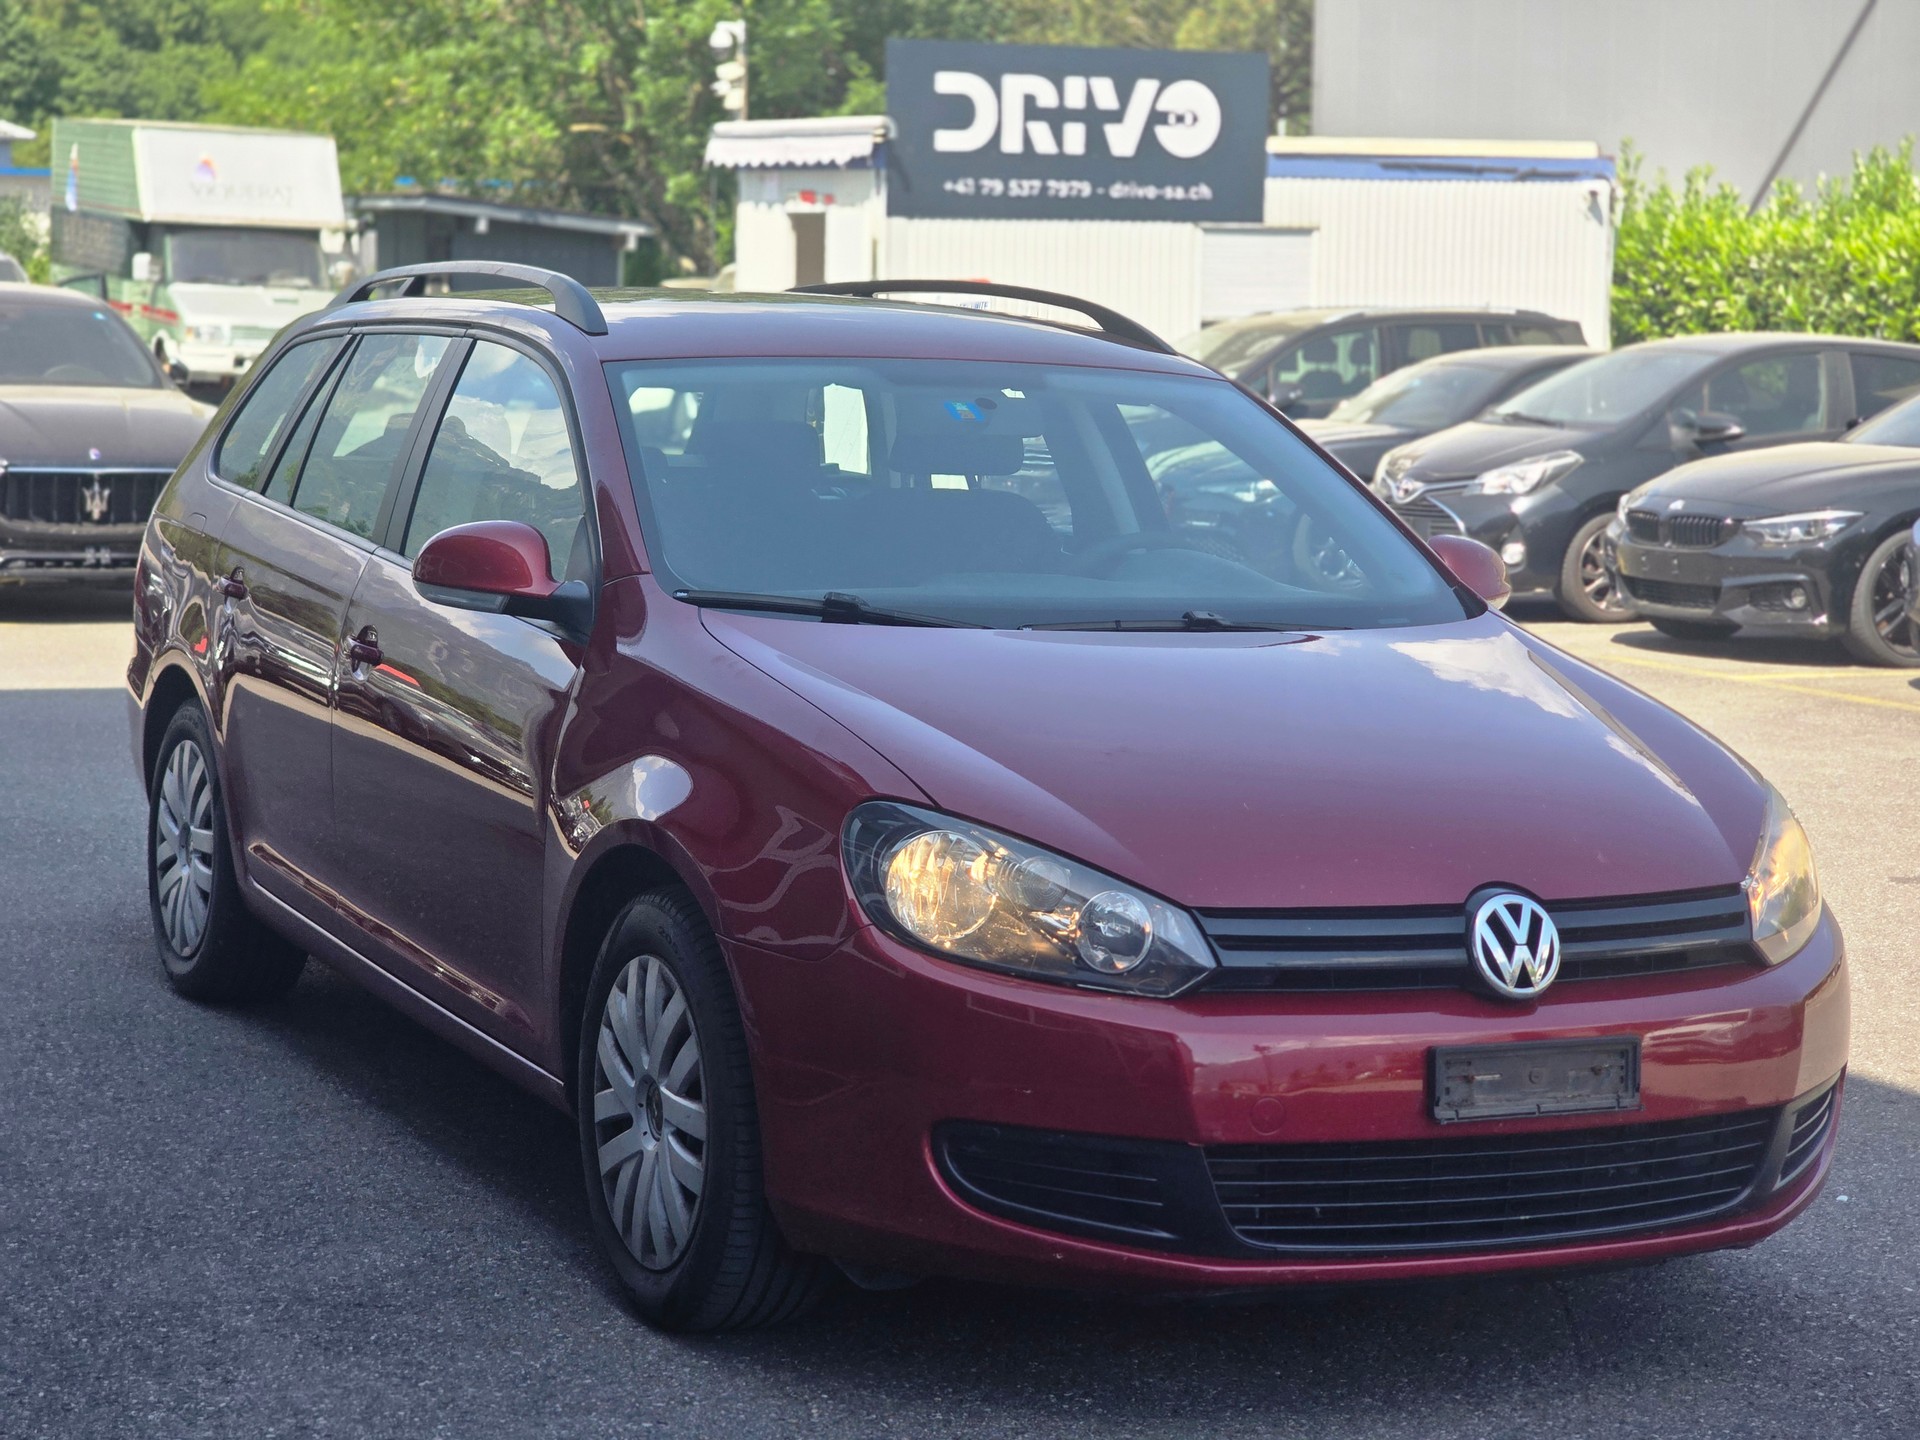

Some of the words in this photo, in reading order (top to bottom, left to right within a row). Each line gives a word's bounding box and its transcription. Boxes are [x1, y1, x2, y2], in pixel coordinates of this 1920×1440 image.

[934, 71, 1221, 158] DRIVO
[979, 178, 1004, 197] 79
[1008, 178, 1041, 198] 537
[1046, 179, 1092, 199] 7979
